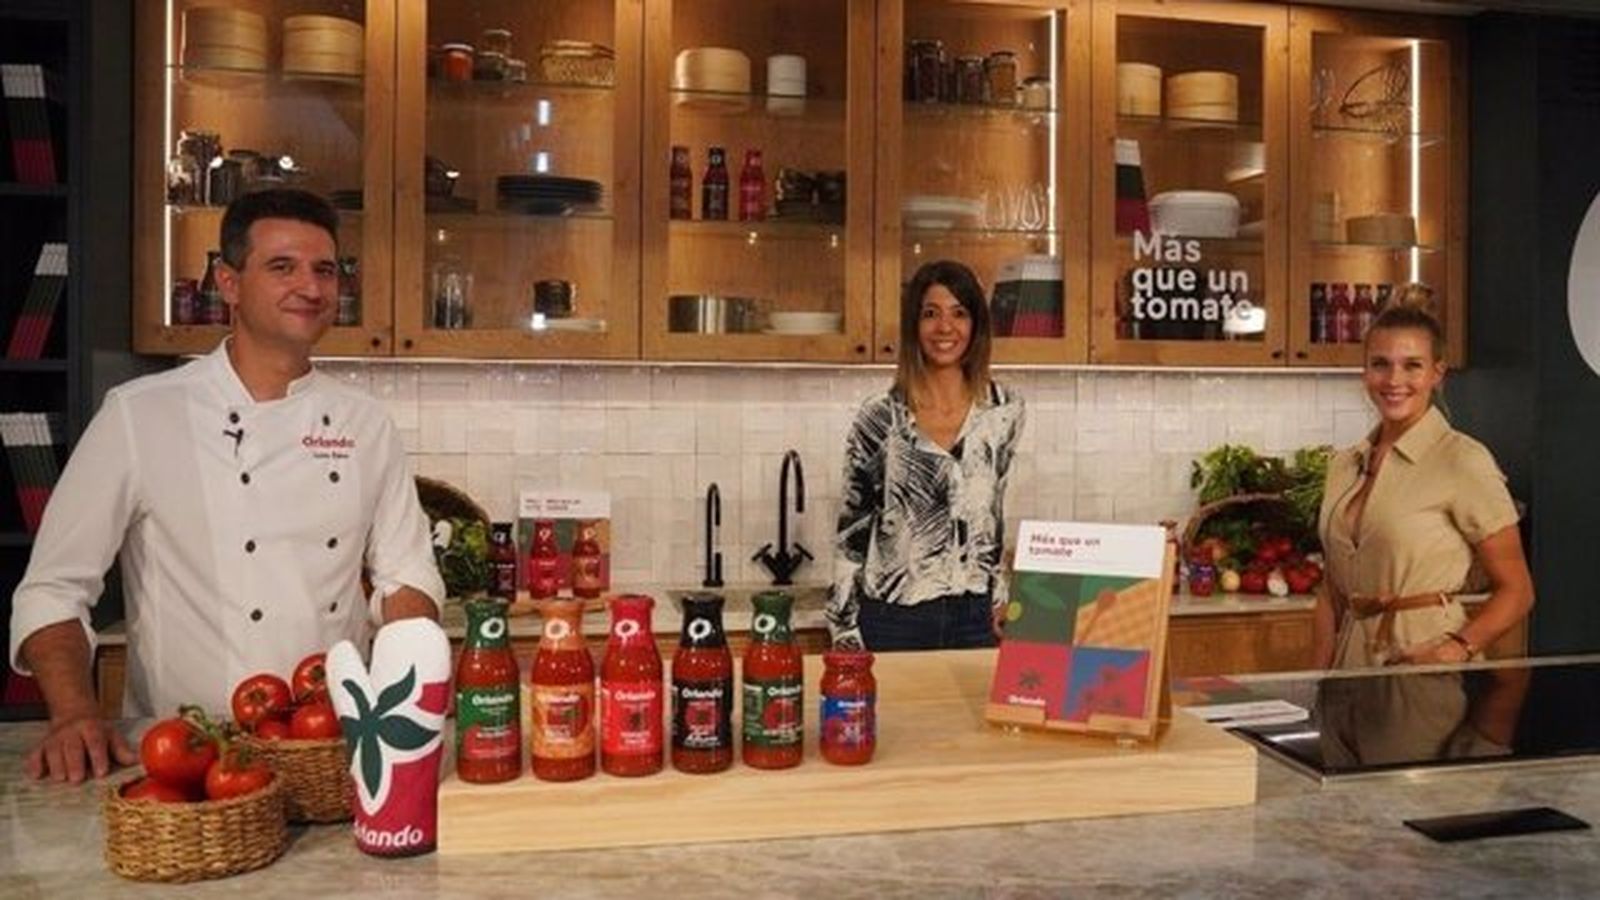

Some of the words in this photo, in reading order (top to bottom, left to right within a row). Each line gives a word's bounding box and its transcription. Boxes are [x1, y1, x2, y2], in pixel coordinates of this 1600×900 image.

[1132, 268, 1196, 297] que
[1208, 269, 1248, 292] un
[1131, 294, 1252, 320] tomate
[682, 687, 723, 698] Orlando
